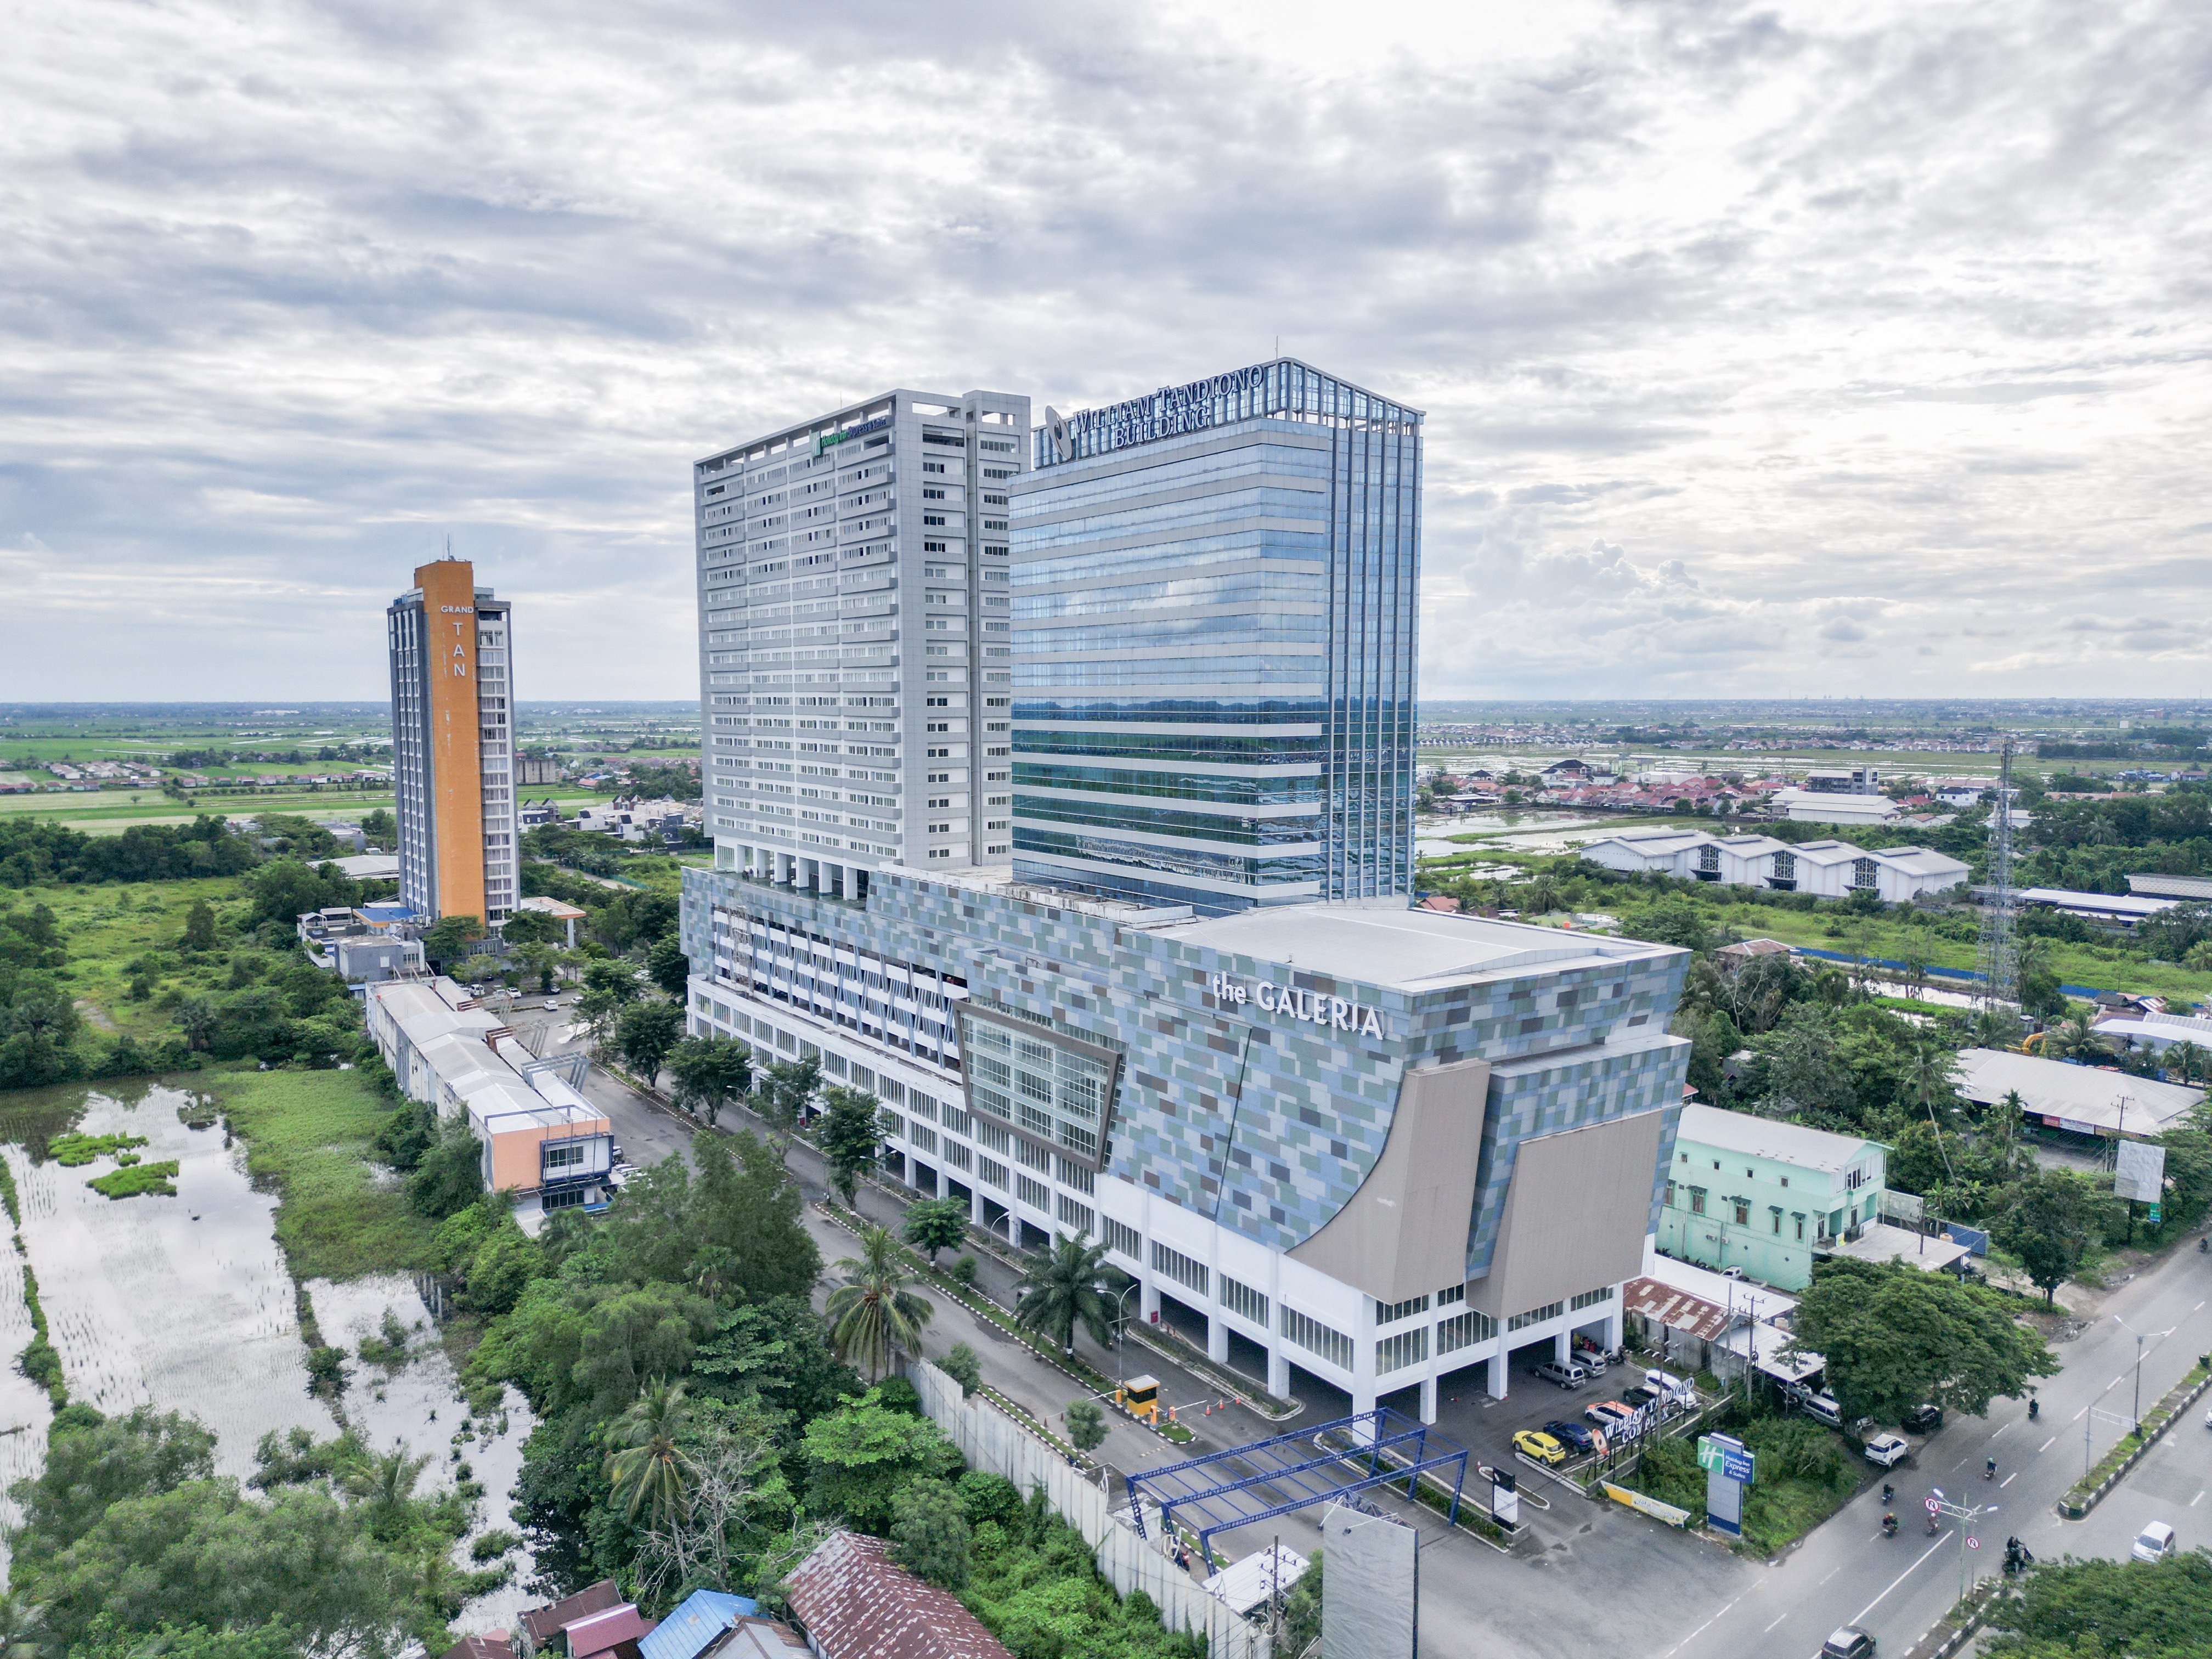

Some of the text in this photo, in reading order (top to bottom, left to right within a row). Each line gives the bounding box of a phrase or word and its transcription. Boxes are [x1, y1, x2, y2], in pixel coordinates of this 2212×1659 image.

[1073, 364, 1263, 433] WILLIAM TANDIONO
[1114, 405, 1210, 448] BUILDING
[441, 605, 474, 613] GRAND
[452, 622, 465, 676] TAN
[1212, 971, 1383, 1040] the GALERIA
[1622, 1407, 1669, 1443] COMPLX
[1725, 1455, 1742, 1465] Holiday
[1725, 1460, 1751, 1474] Express
